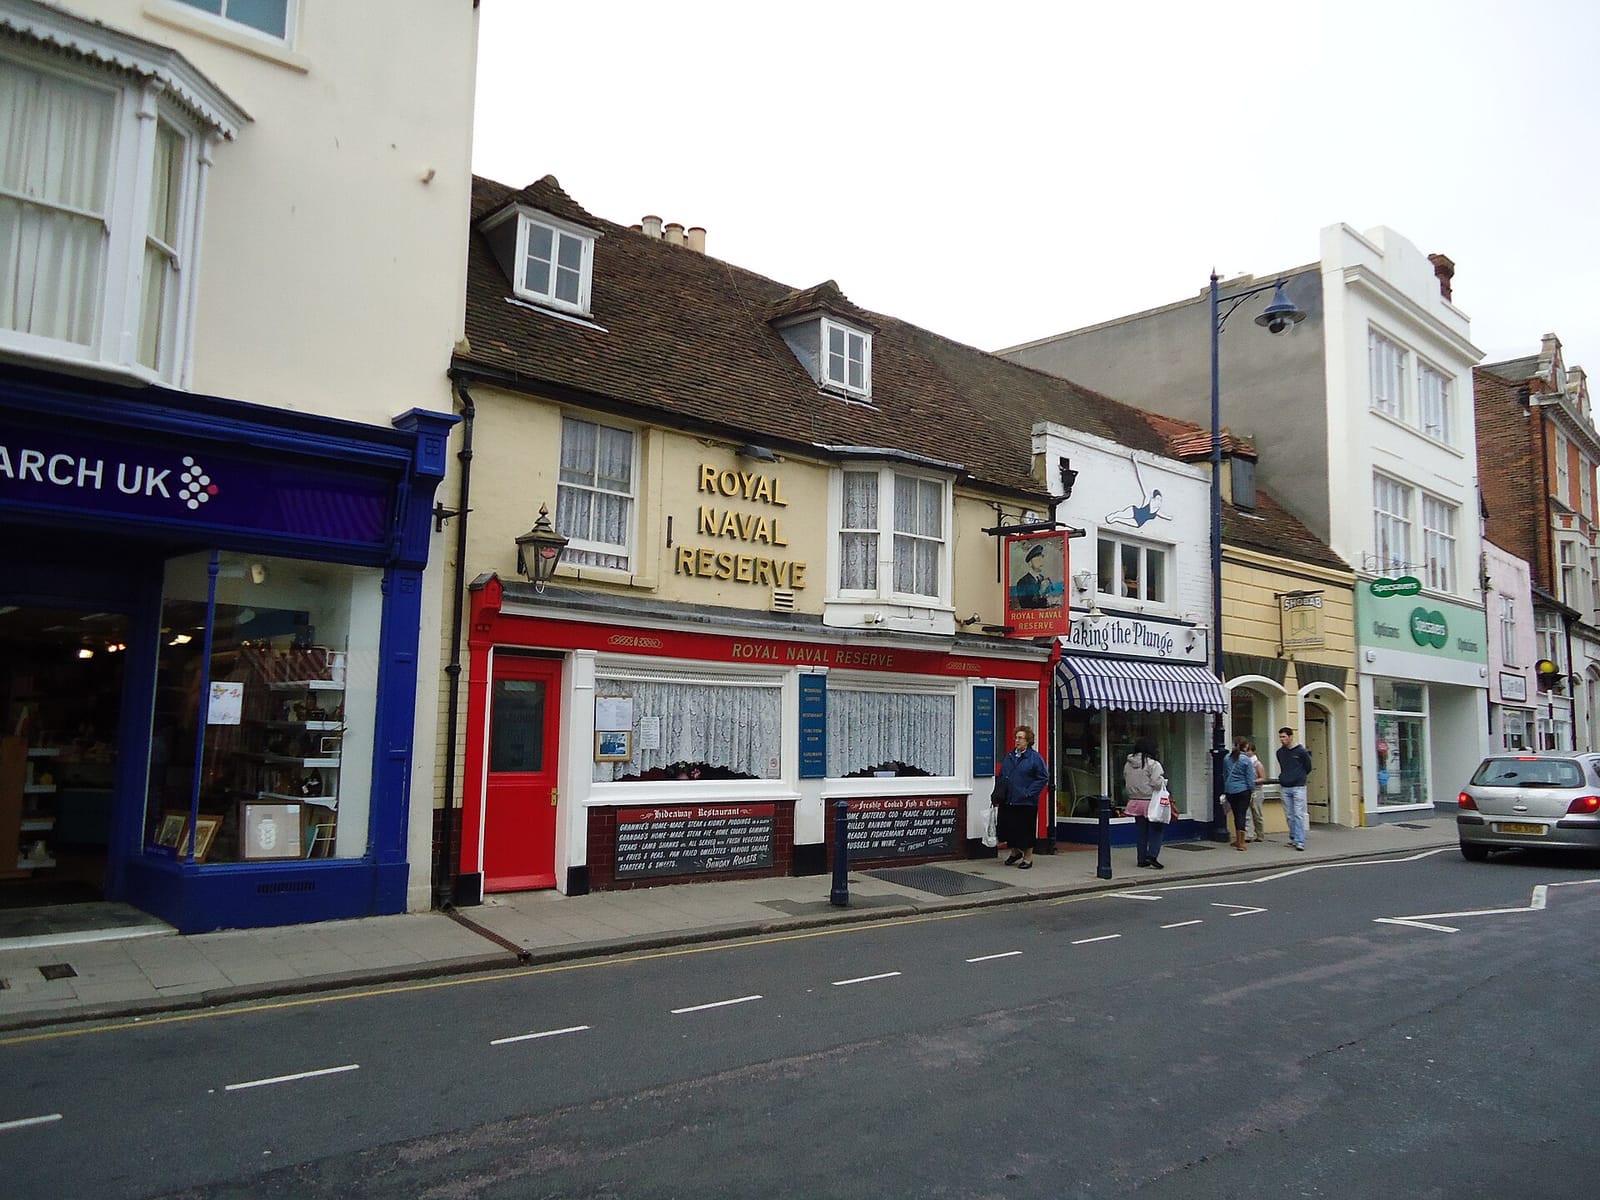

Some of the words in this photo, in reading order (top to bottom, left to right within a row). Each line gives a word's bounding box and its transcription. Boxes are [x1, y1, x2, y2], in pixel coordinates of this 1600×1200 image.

[0, 446, 104, 490] ARCH
[117, 463, 172, 498] UK
[698, 463, 789, 508] ROYAL
[698, 504, 789, 548] NAVAL
[675, 545, 807, 589] RESERVE
[1371, 582, 1418, 593] Specsavers
[1011, 612, 1035, 621] ROYAL
[1038, 610, 1062, 619] NAVAL
[1018, 621, 1054, 630] RESERVE
[1414, 616, 1446, 636] Specsavers
[1067, 619, 1110, 651] Taking
[1111, 620, 1131, 644] the
[1132, 621, 1173, 656] Plunge
[731, 643, 779, 660] ROYAL
[786, 647, 830, 663] NAVAL
[835, 650, 894, 667] RESERVE
[904, 799, 917, 809] Fish
[653, 809, 693, 819] Hideaway
[698, 807, 739, 818] Restaurant
[847, 821, 866, 830] RILLED
[847, 831, 868, 840] READED
